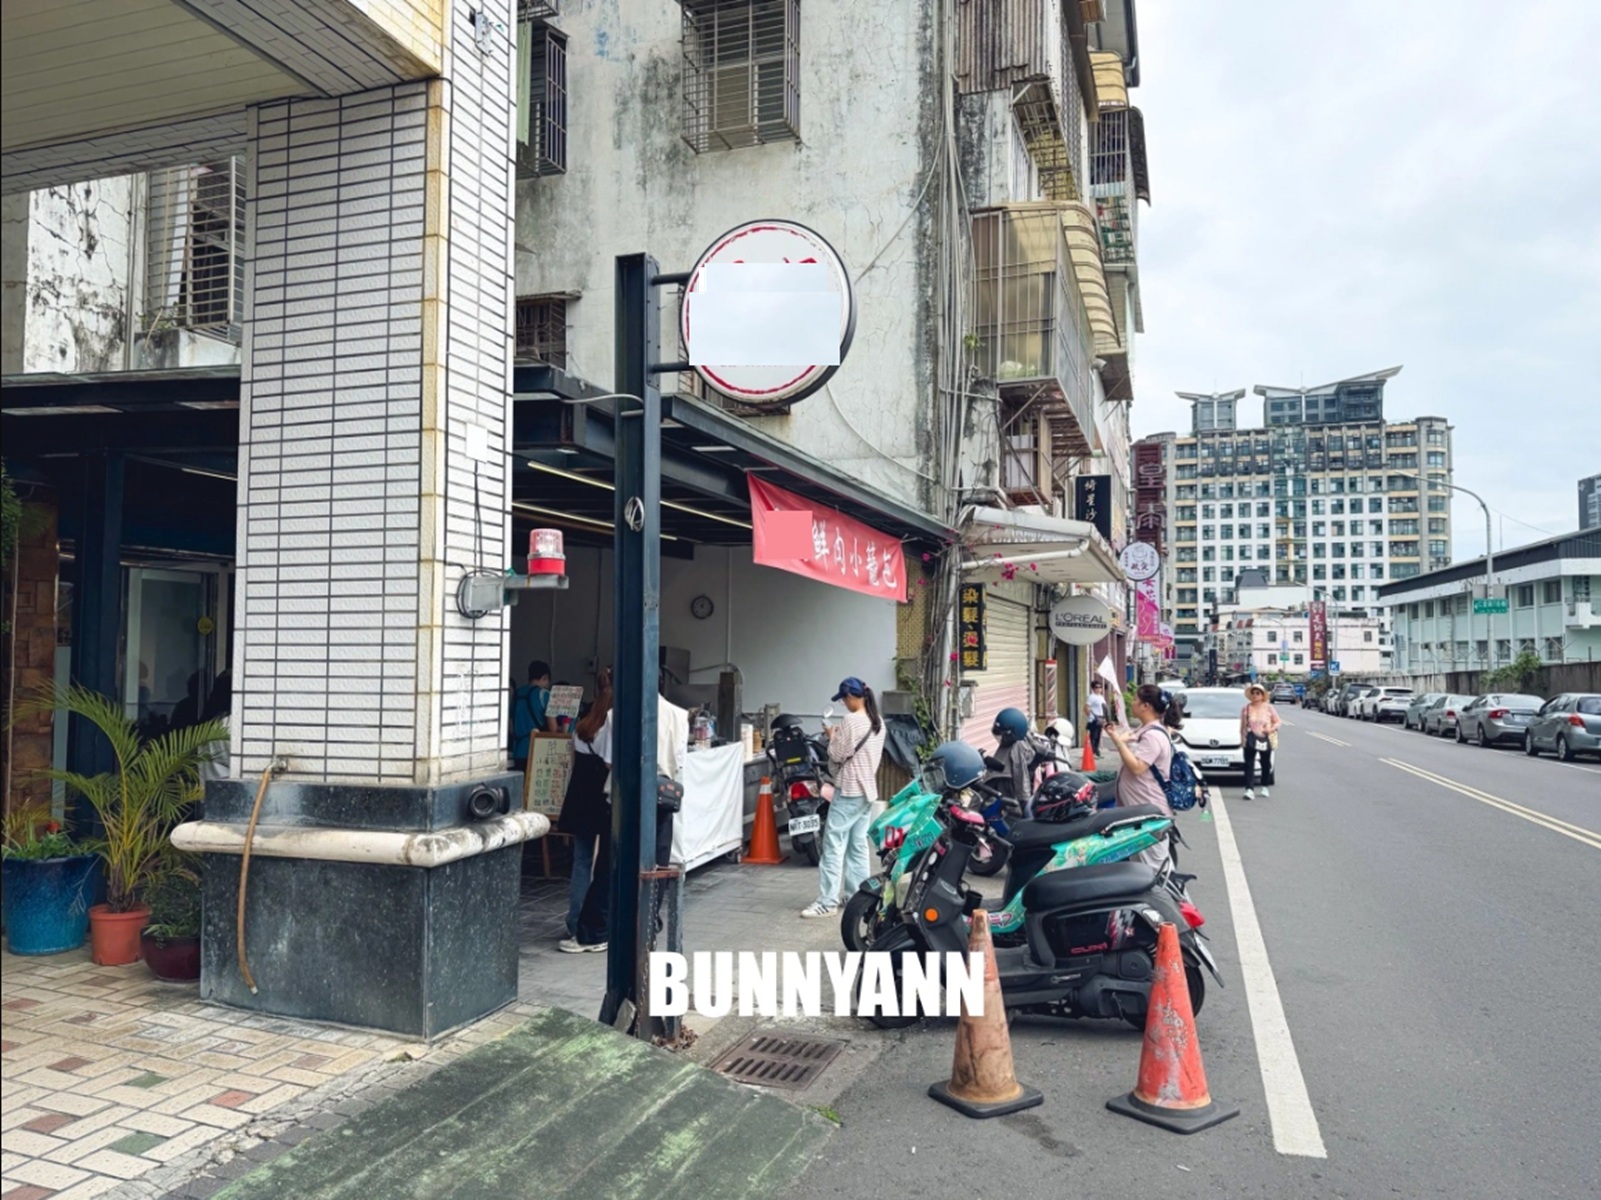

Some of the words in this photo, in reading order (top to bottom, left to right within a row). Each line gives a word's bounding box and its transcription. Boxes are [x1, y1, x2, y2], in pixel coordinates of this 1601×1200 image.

[812, 519, 897, 589] 鮮肉小籠包
